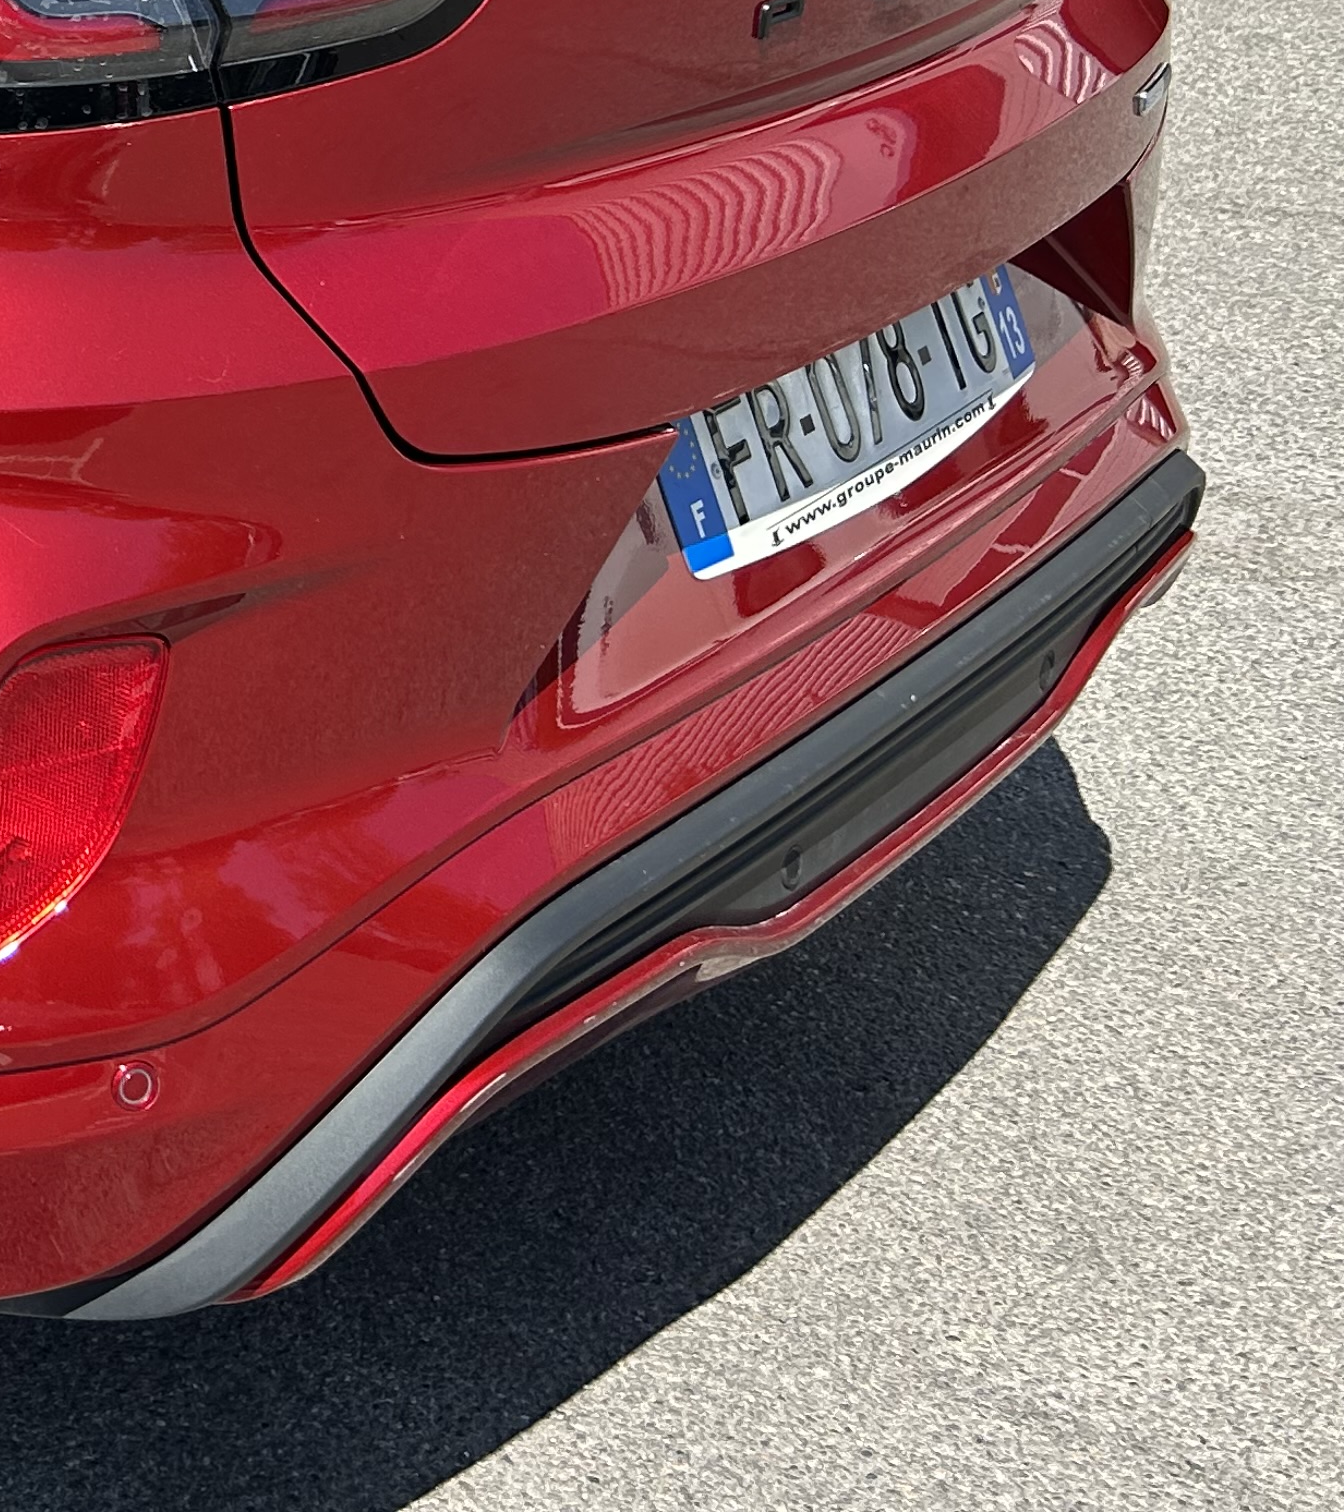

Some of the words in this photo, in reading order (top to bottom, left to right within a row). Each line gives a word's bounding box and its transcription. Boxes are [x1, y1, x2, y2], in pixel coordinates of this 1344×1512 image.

[998, 306, 1026, 360] 13
[784, 401, 988, 535] www.groupe-maurin.com
[689, 500, 706, 538] F
